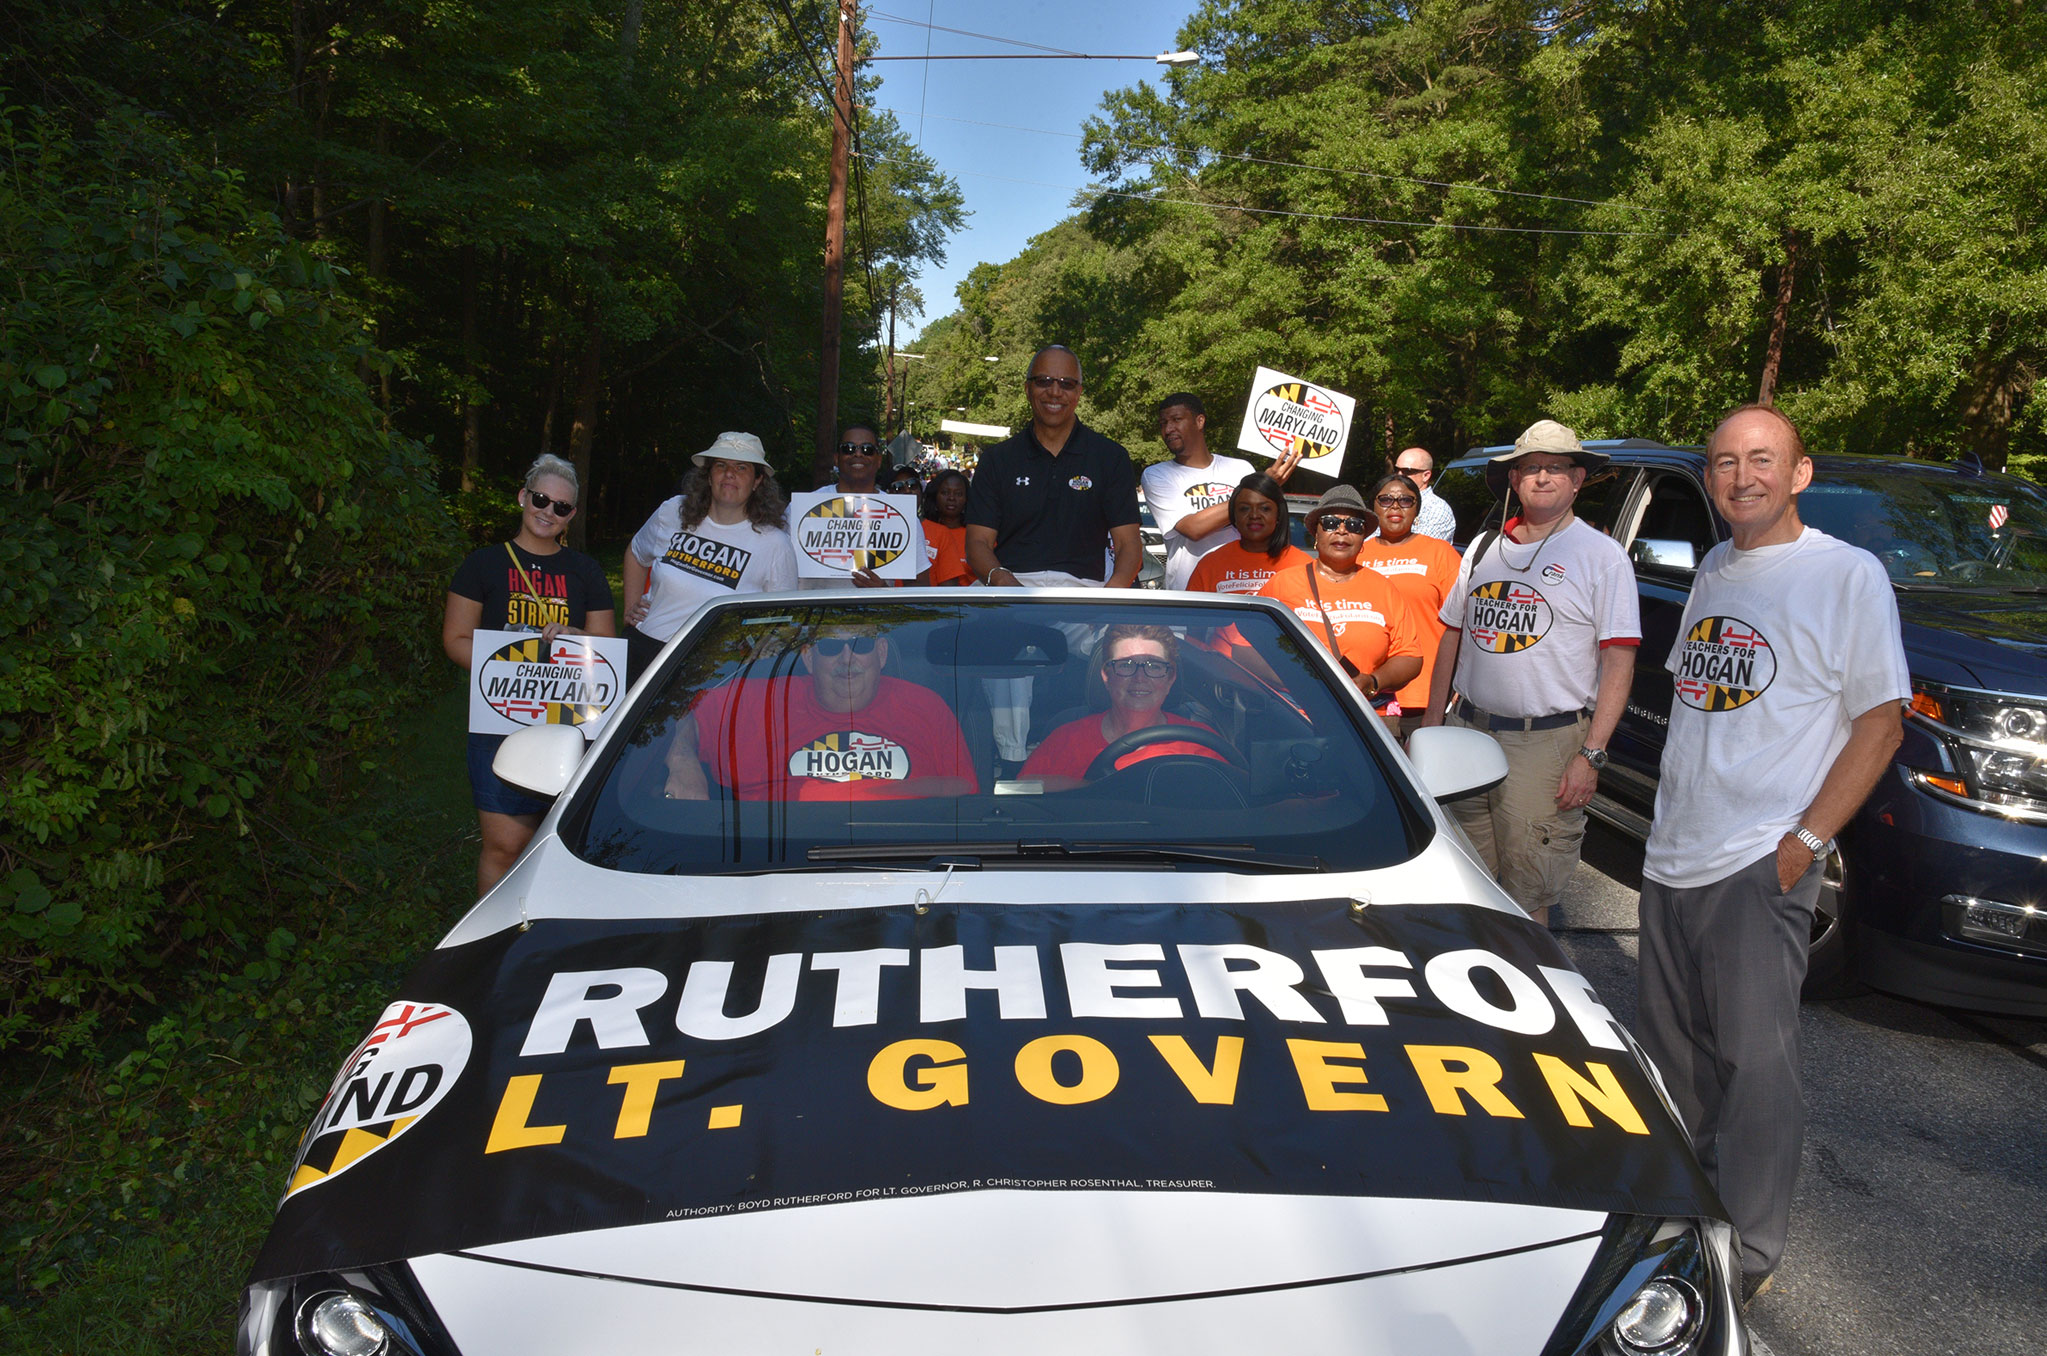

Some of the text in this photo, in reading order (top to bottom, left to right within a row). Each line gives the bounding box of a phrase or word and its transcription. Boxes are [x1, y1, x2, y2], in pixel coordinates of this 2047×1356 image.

[1282, 402, 1324, 424] CHANGING
[1259, 408, 1338, 445] MARYLAND
[827, 519, 881, 531] CHANGNG
[805, 531, 903, 549] MARYLAND
[666, 550, 740, 579] RUTHERFORD
[669, 534, 749, 572] HOGAN
[1362, 558, 1418, 568] It is time
[508, 568, 568, 597] HOGAN
[1226, 571, 1235, 579] It
[1239, 569, 1249, 579] is
[508, 600, 569, 627] STRONG
[1305, 599, 1372, 611] It is time
[1475, 598, 1538, 612] TEACHERS FOR
[1474, 606, 1536, 632] HOGAN
[1683, 641, 1756, 659] TEACHERS FOR
[516, 664, 582, 680] CHANGING
[1679, 651, 1754, 686] HOGAN
[487, 677, 609, 703] MARYLAND
[807, 750, 892, 772] HOGAN
[484, 1035, 1650, 1154] LT. GOVERN
[666, 1204, 735, 1218] AUTHORITY:
[738, 1199, 770, 1210] BOYD
[774, 1191, 852, 1206] RUTHERFORD
[856, 1189, 880, 1198] FOR
[883, 1187, 897, 1196] LT.
[901, 1180, 970, 1194] GOVERNOR,
[987, 1178, 1067, 1188] CHRISTOPHER
[1070, 1179, 1143, 1188] ROSENTHAL,
[1146, 1179, 1217, 1188] TREASURER.
